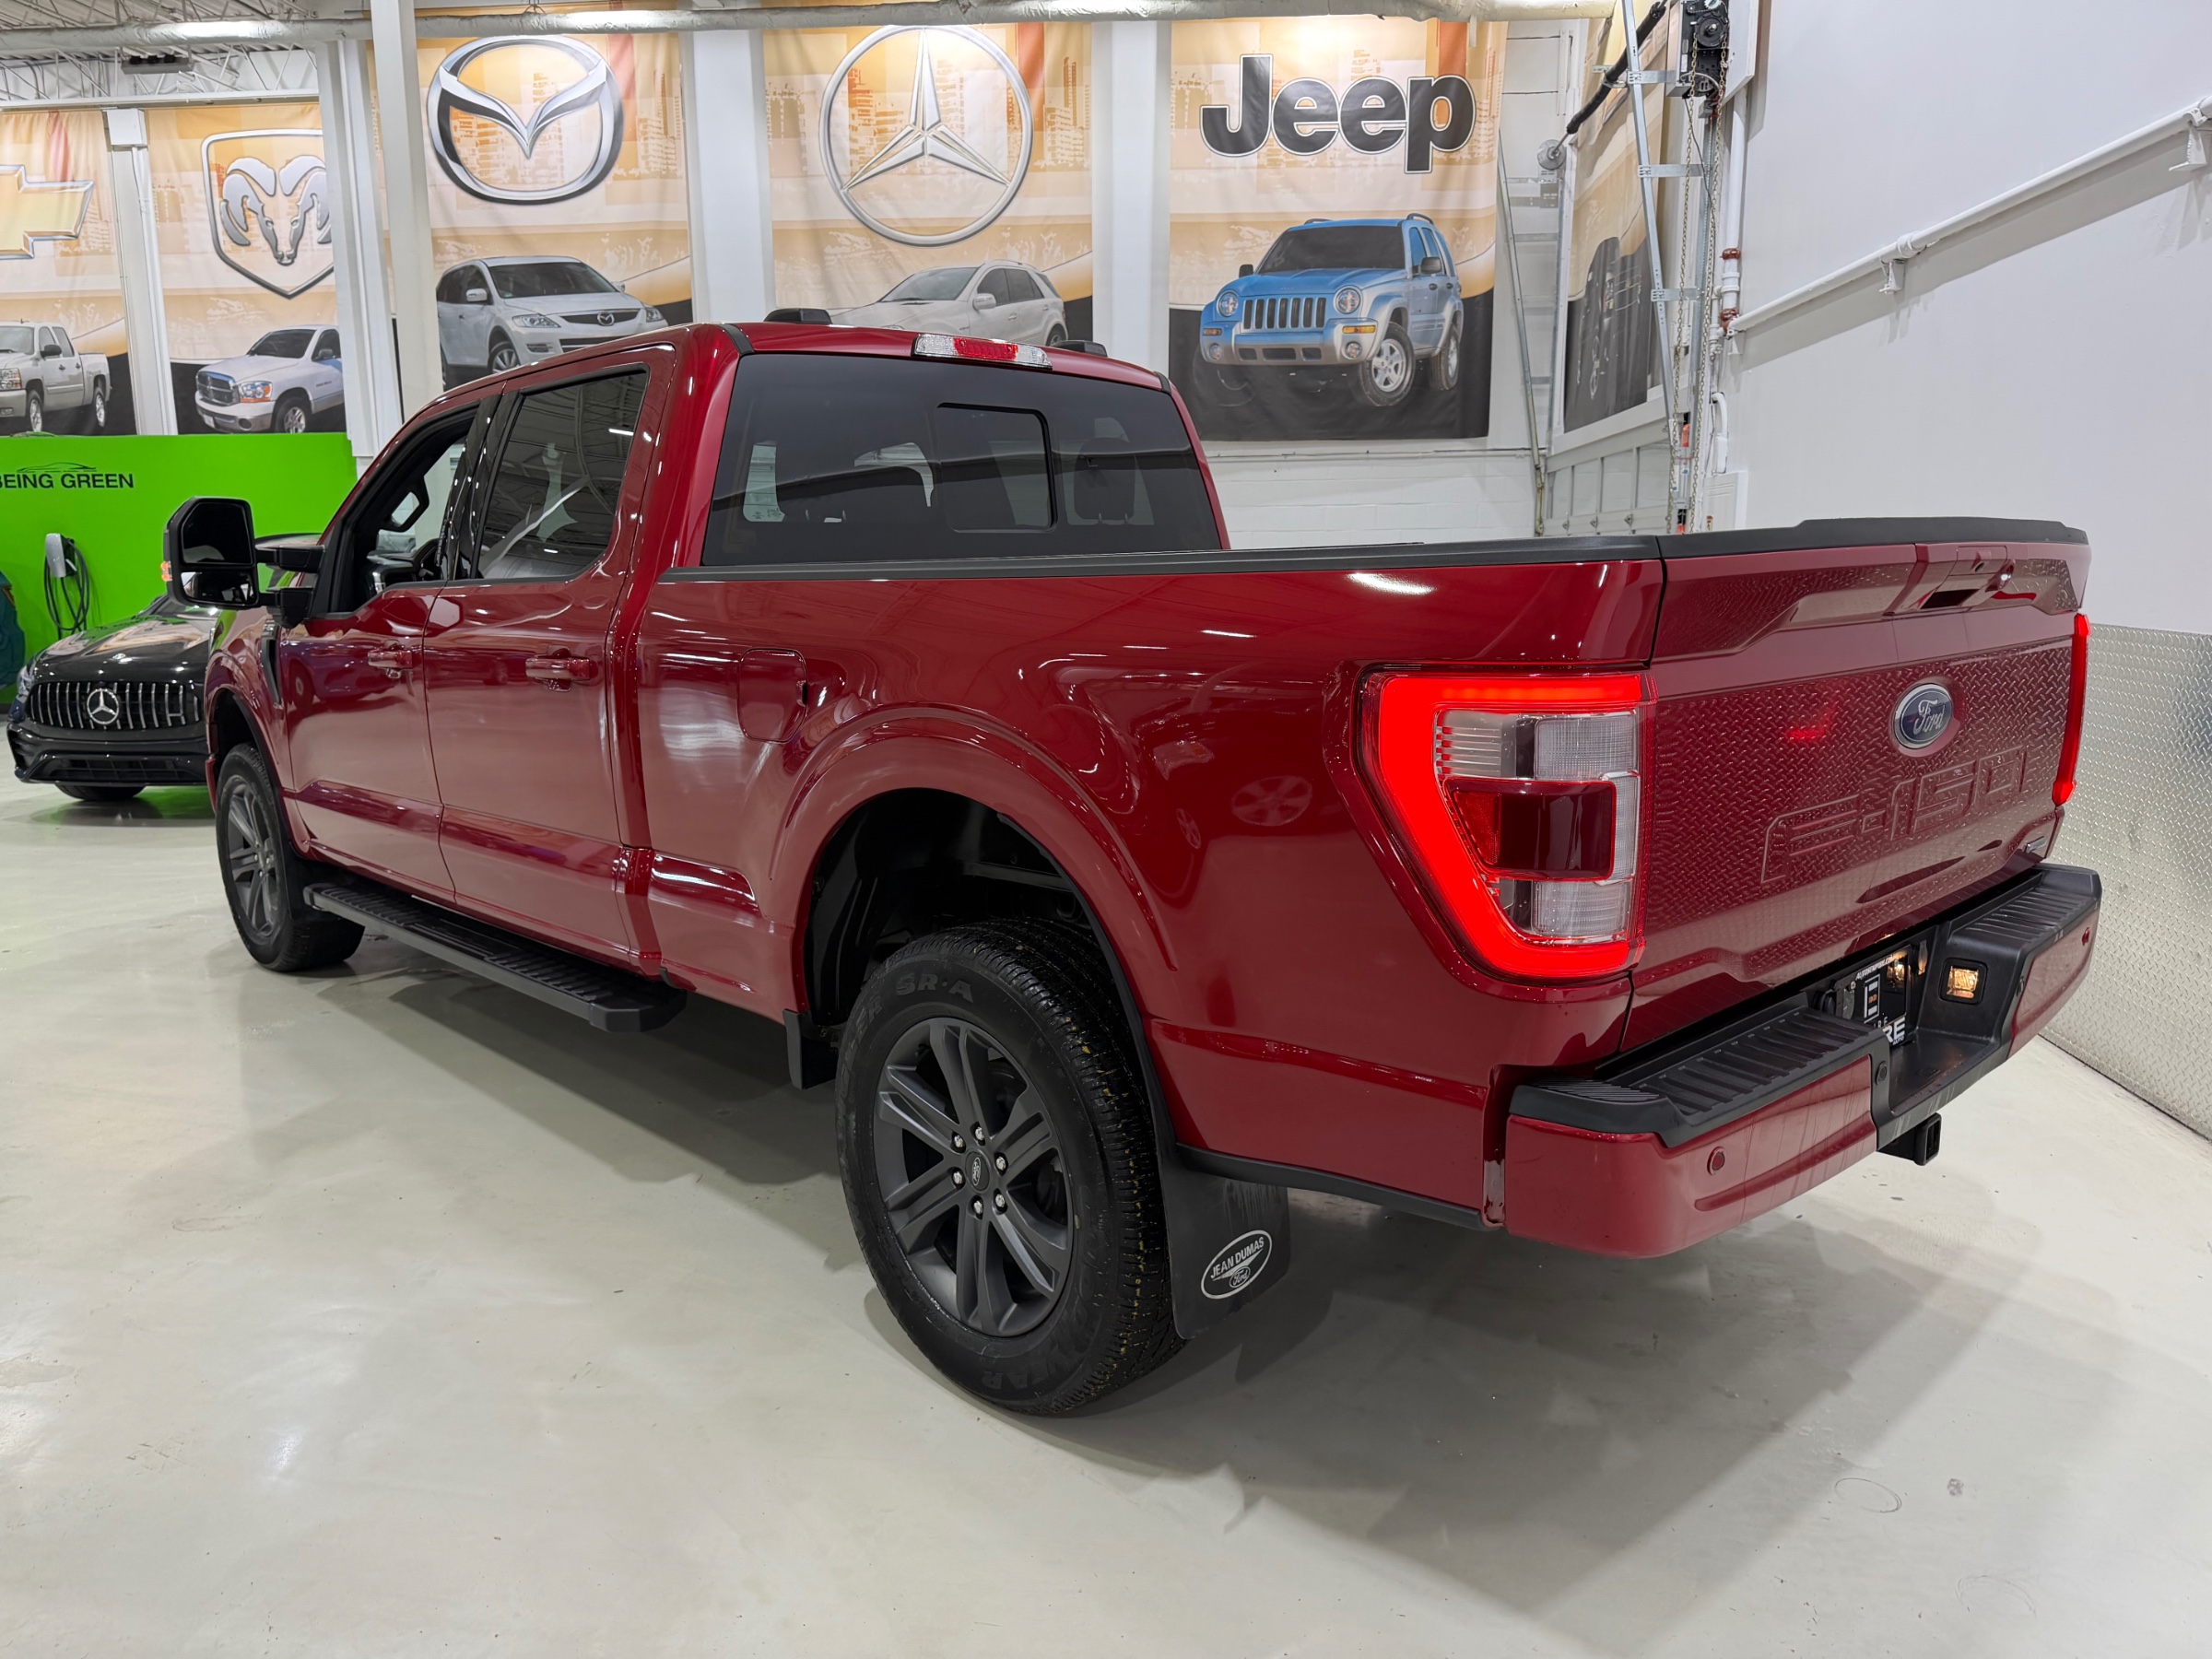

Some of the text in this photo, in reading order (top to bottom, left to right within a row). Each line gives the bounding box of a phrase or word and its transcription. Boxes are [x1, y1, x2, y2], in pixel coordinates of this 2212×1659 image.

[1200, 53, 1476, 173] Jeep
[0, 473, 135, 488] EING GREEN
[1912, 699, 1946, 735] Ford
[1760, 744, 2026, 884] F-150
[1210, 1236, 1264, 1279] JEAN DUMAS
[1232, 1269, 1248, 1285] Ford
